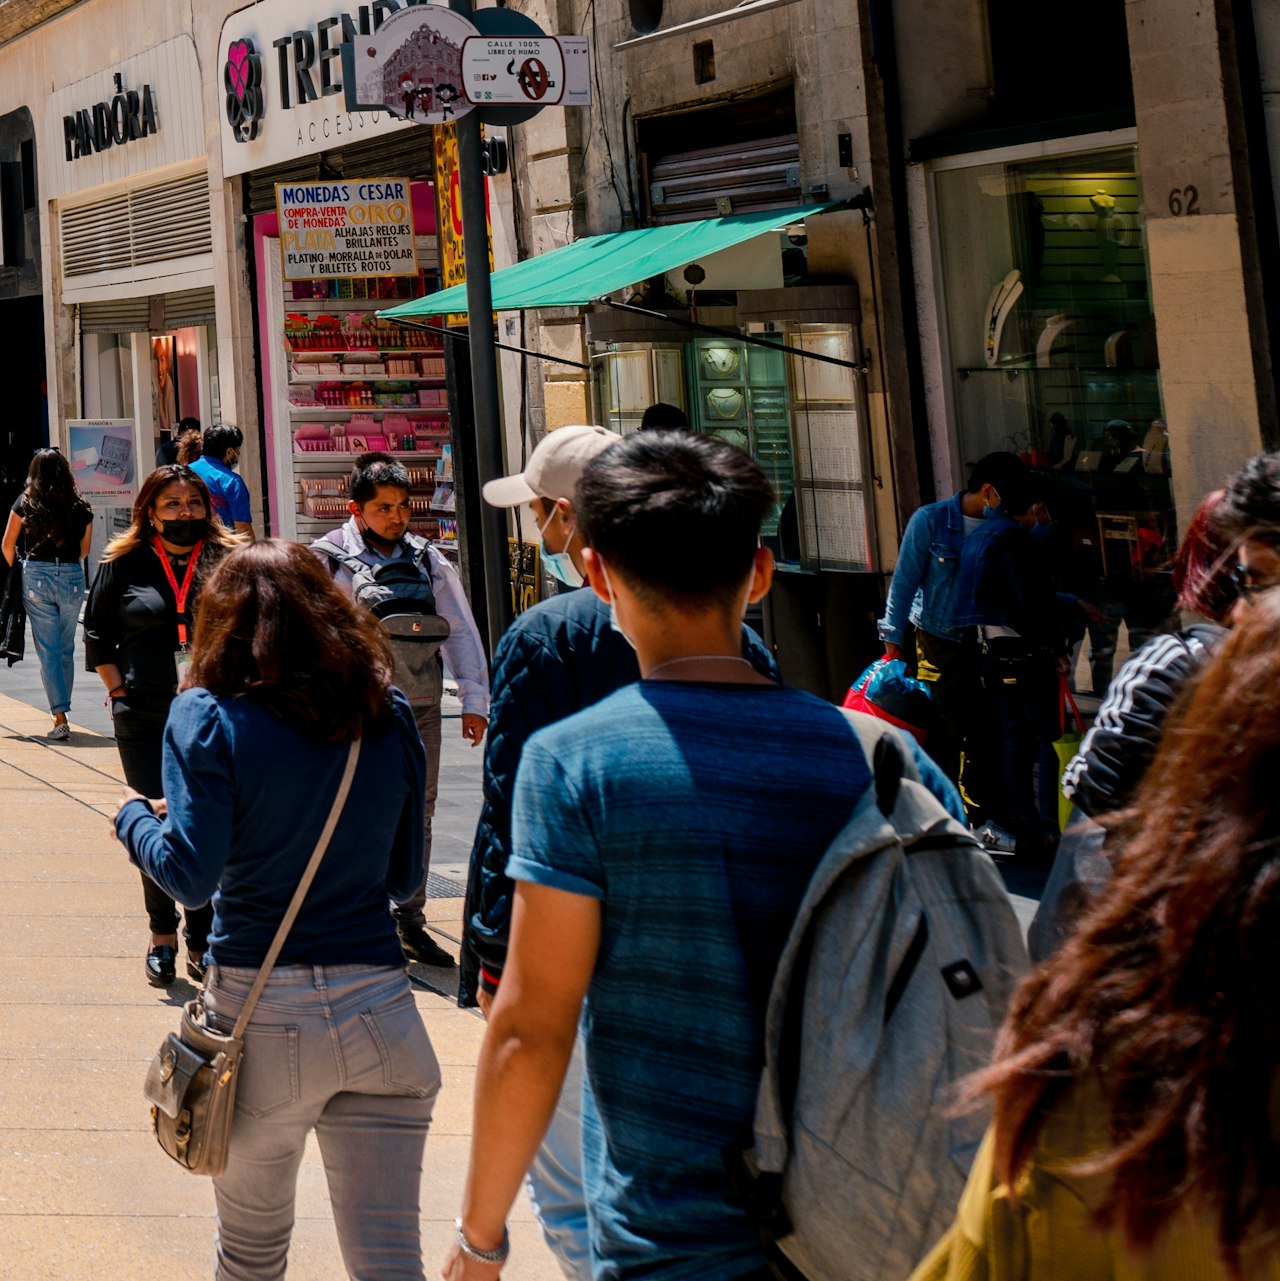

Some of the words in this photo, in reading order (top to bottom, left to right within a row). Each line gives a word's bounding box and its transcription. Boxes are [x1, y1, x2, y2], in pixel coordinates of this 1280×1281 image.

[297, 109, 380, 146] ACCESSO
[283, 185, 350, 204] MONEDAS
[358, 183, 404, 200] CESAR
[1167, 184, 1200, 218] 62
[348, 202, 408, 225] ORO
[288, 219, 298, 229] DE
[303, 217, 346, 228] MONEDAS
[335, 226, 374, 238] ALHAJAS
[376, 225, 411, 235] RELOJES
[283, 230, 336, 251] PLATA
[346, 237, 399, 249] BRILLANTES
[288, 253, 324, 264] PLATINO
[329, 251, 374, 262] MORRALLA
[383, 249, 413, 260] DOLAR
[309, 264, 316, 274] Y
[319, 262, 357, 274] BILLETES
[361, 261, 391, 272] ROTOS
